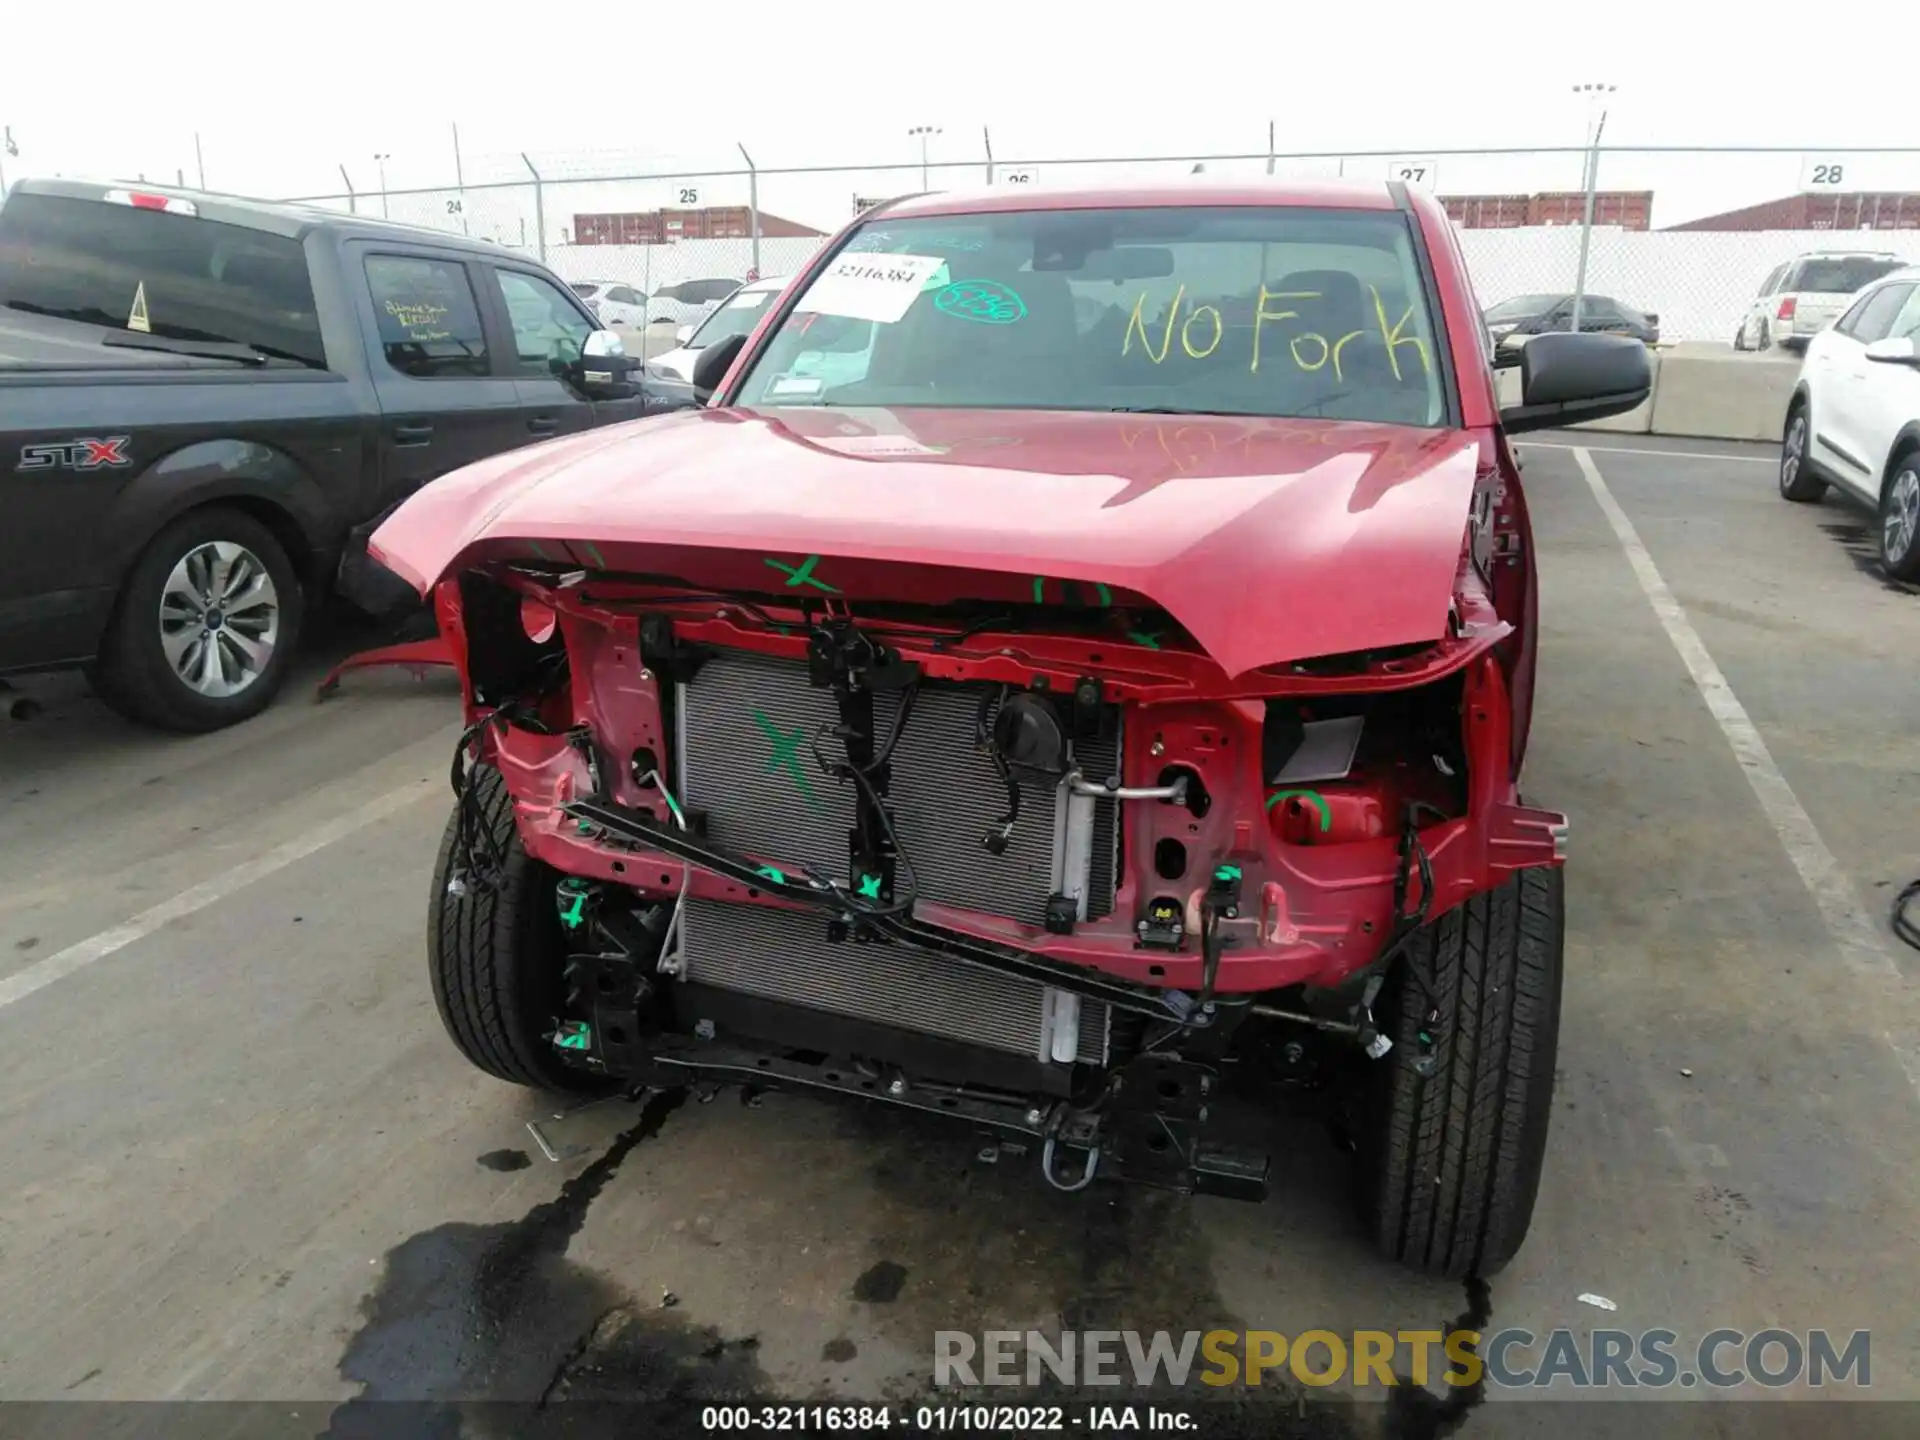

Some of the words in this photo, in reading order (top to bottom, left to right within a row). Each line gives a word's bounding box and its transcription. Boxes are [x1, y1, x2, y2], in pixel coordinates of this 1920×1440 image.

[1400, 168, 1426, 182] 27
[1811, 165, 1843, 184] 28
[680, 189, 697, 203] 25
[446, 200, 462, 213] 24
[15, 435, 134, 471] STX
